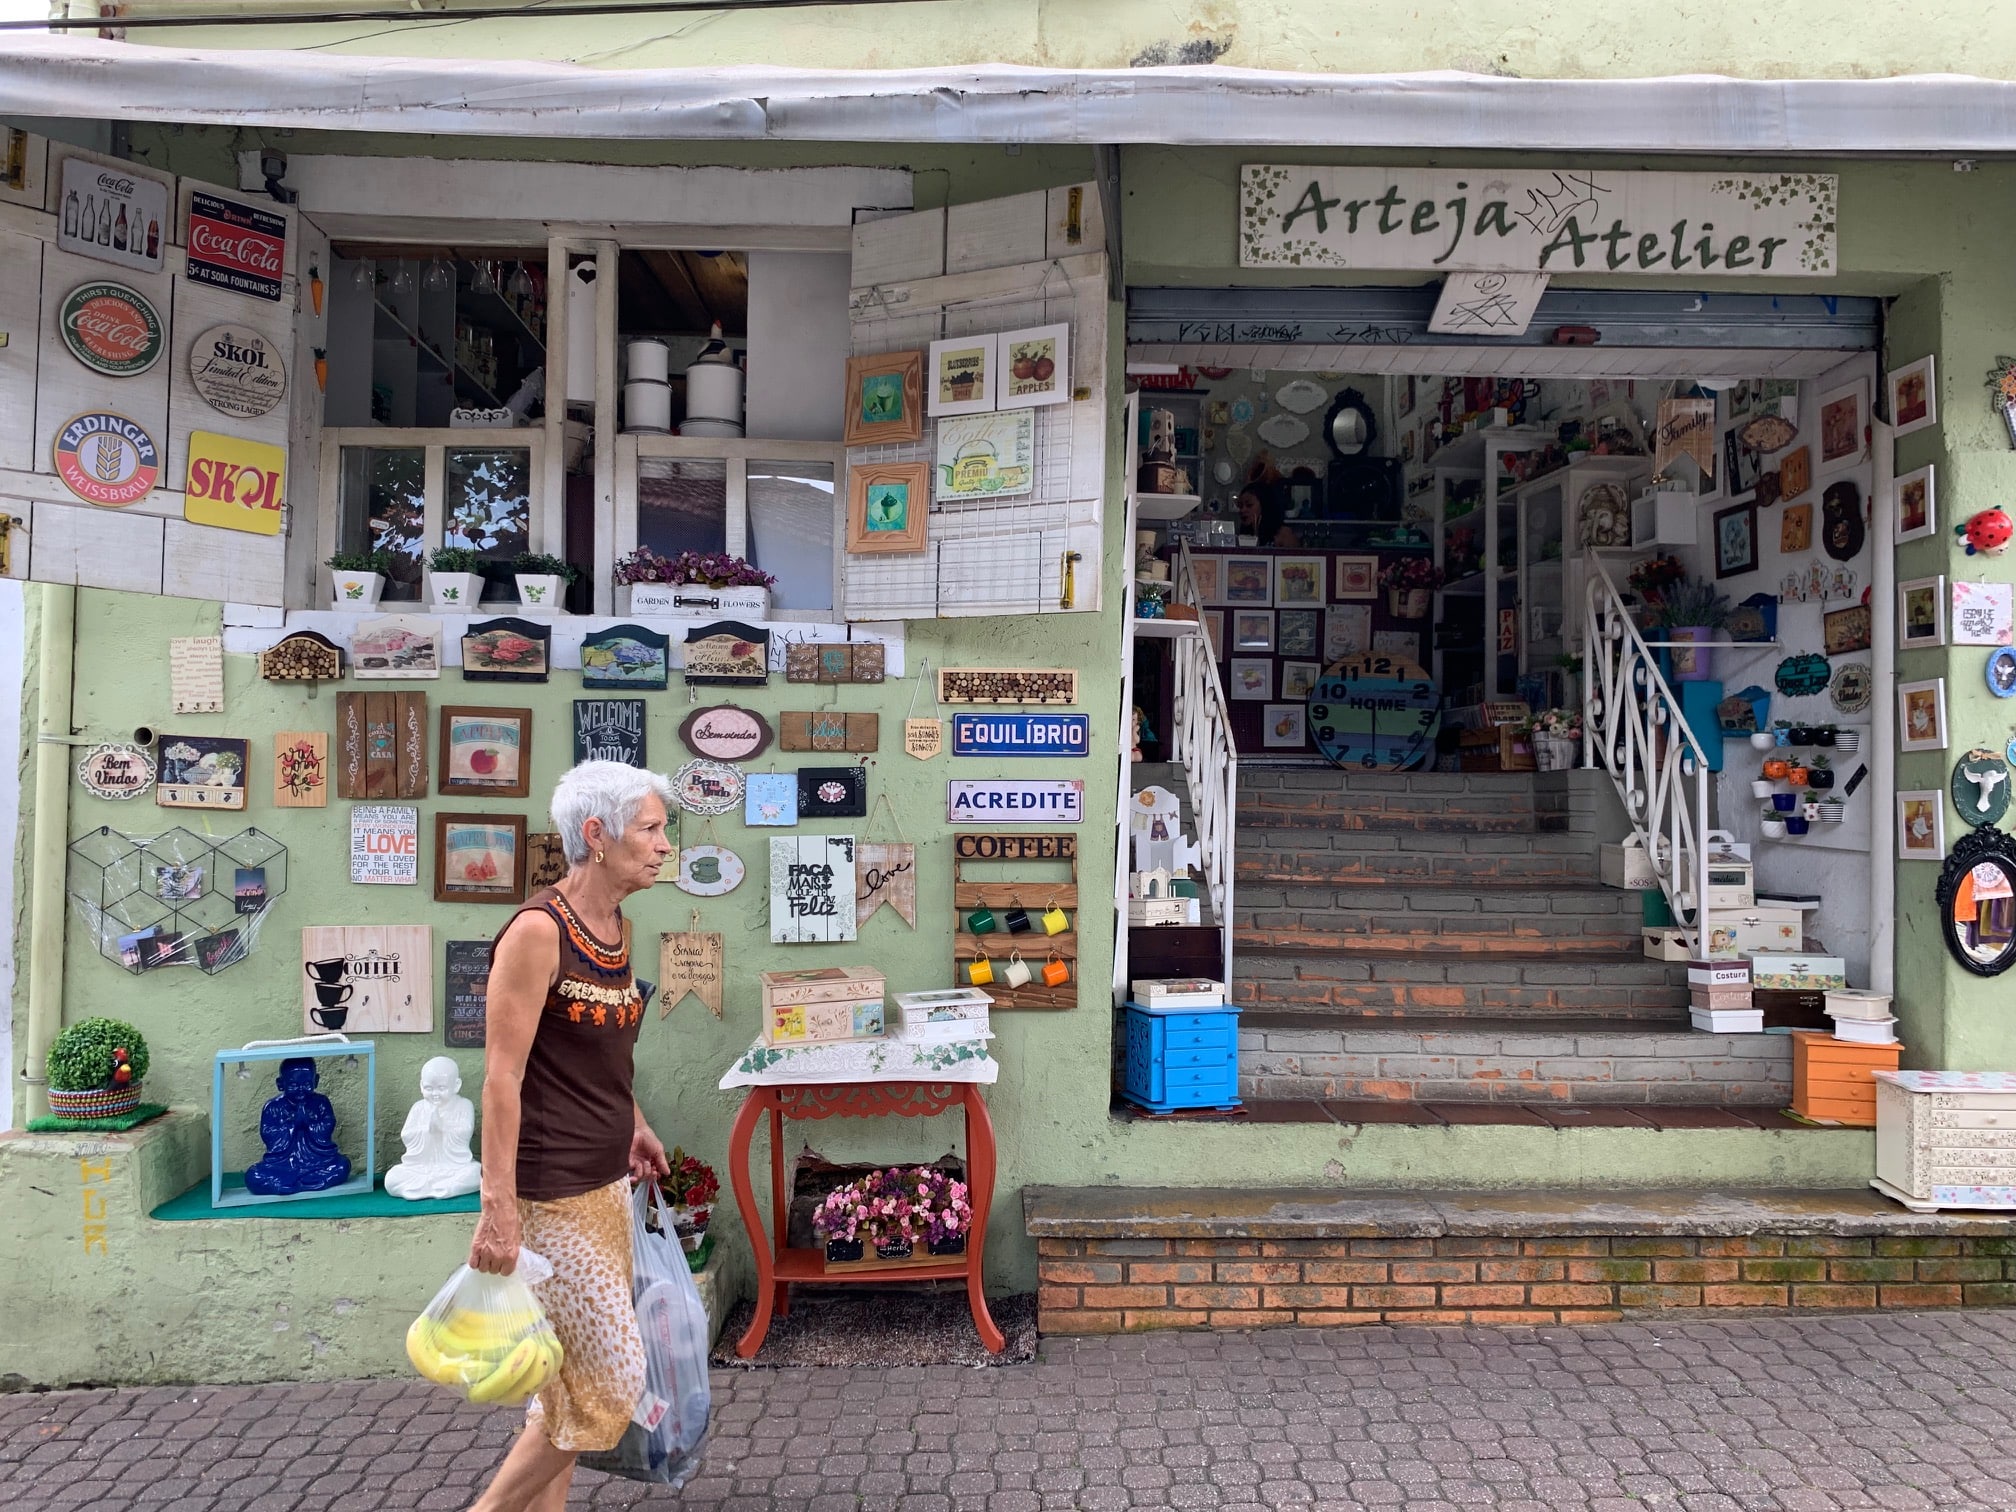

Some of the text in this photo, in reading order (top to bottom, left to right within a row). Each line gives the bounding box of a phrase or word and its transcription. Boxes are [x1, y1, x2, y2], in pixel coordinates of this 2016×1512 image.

[193, 195, 225, 210] DELICIOUS
[253, 213, 284, 227] REFRESHING
[1282, 181, 1518, 264] Arteja
[192, 224, 279, 271] Coca-Cola
[1540, 216, 1787, 270] Atelier
[200, 268, 211, 278] AT
[211, 270, 229, 283] SODA
[231, 276, 270, 294] FOUNTAINS
[76, 288, 157, 329] THIRST QUENCHING
[91, 299, 143, 324] DELICIOUS AND
[93, 311, 120, 324] DRINK
[67, 309, 158, 352] Coca-Cola
[85, 336, 134, 358] REFRESHING
[213, 341, 269, 369] SKOL
[193, 357, 243, 379] Limited
[239, 365, 279, 388] Edition
[1016, 382, 1050, 395] APPLES
[209, 398, 266, 415] STRONG LAGER
[1658, 410, 1709, 447] Family
[63, 416, 154, 459] ERDINGER
[955, 468, 989, 479] PREMIU
[187, 457, 283, 511] SKOL
[637, 597, 760, 609] GARDEN FLOWERS
[1502, 611, 1514, 649] PAZ
[1339, 665, 1359, 682] 11
[1363, 657, 1392, 674] 12
[1396, 667, 1405, 683] 1
[1319, 682, 1347, 699] 10
[1412, 682, 1430, 699] 2
[1312, 704, 1329, 721] 9
[1350, 697, 1406, 712] HOME
[577, 701, 642, 733] WELCOME
[1418, 710, 1435, 726] 3
[960, 718, 1083, 745] EQUILÍBRIO
[1318, 725, 1336, 742] 8
[1407, 730, 1424, 744] 4
[371, 751, 392, 759] CASA
[585, 735, 632, 763] home
[1335, 744, 1350, 761] 7
[1389, 748, 1405, 764] 5
[101, 754, 131, 770] Bem
[1361, 752, 1378, 769] 6
[94, 770, 138, 785] Vindos
[954, 791, 1076, 809] ACREDITE
[353, 806, 415, 815] BEING A FAMILY
[353, 834, 366, 853] WILL
[366, 834, 416, 854] LOVE
[956, 835, 1075, 858] COFFEE
[364, 875, 393, 883] MATTER
[394, 876, 417, 884] WHAT
[788, 876, 822, 890] MAIS
[859, 862, 911, 900] love
[1633, 878, 1650, 888] SOS
[1709, 874, 1740, 884] emédios
[786, 889, 792, 897] O
[795, 889, 813, 897] QUE
[787, 896, 838, 918] Feliz
[343, 961, 403, 975] COFFEE
[1715, 971, 1747, 980] Costura
[455, 995, 465, 1003] PUT
